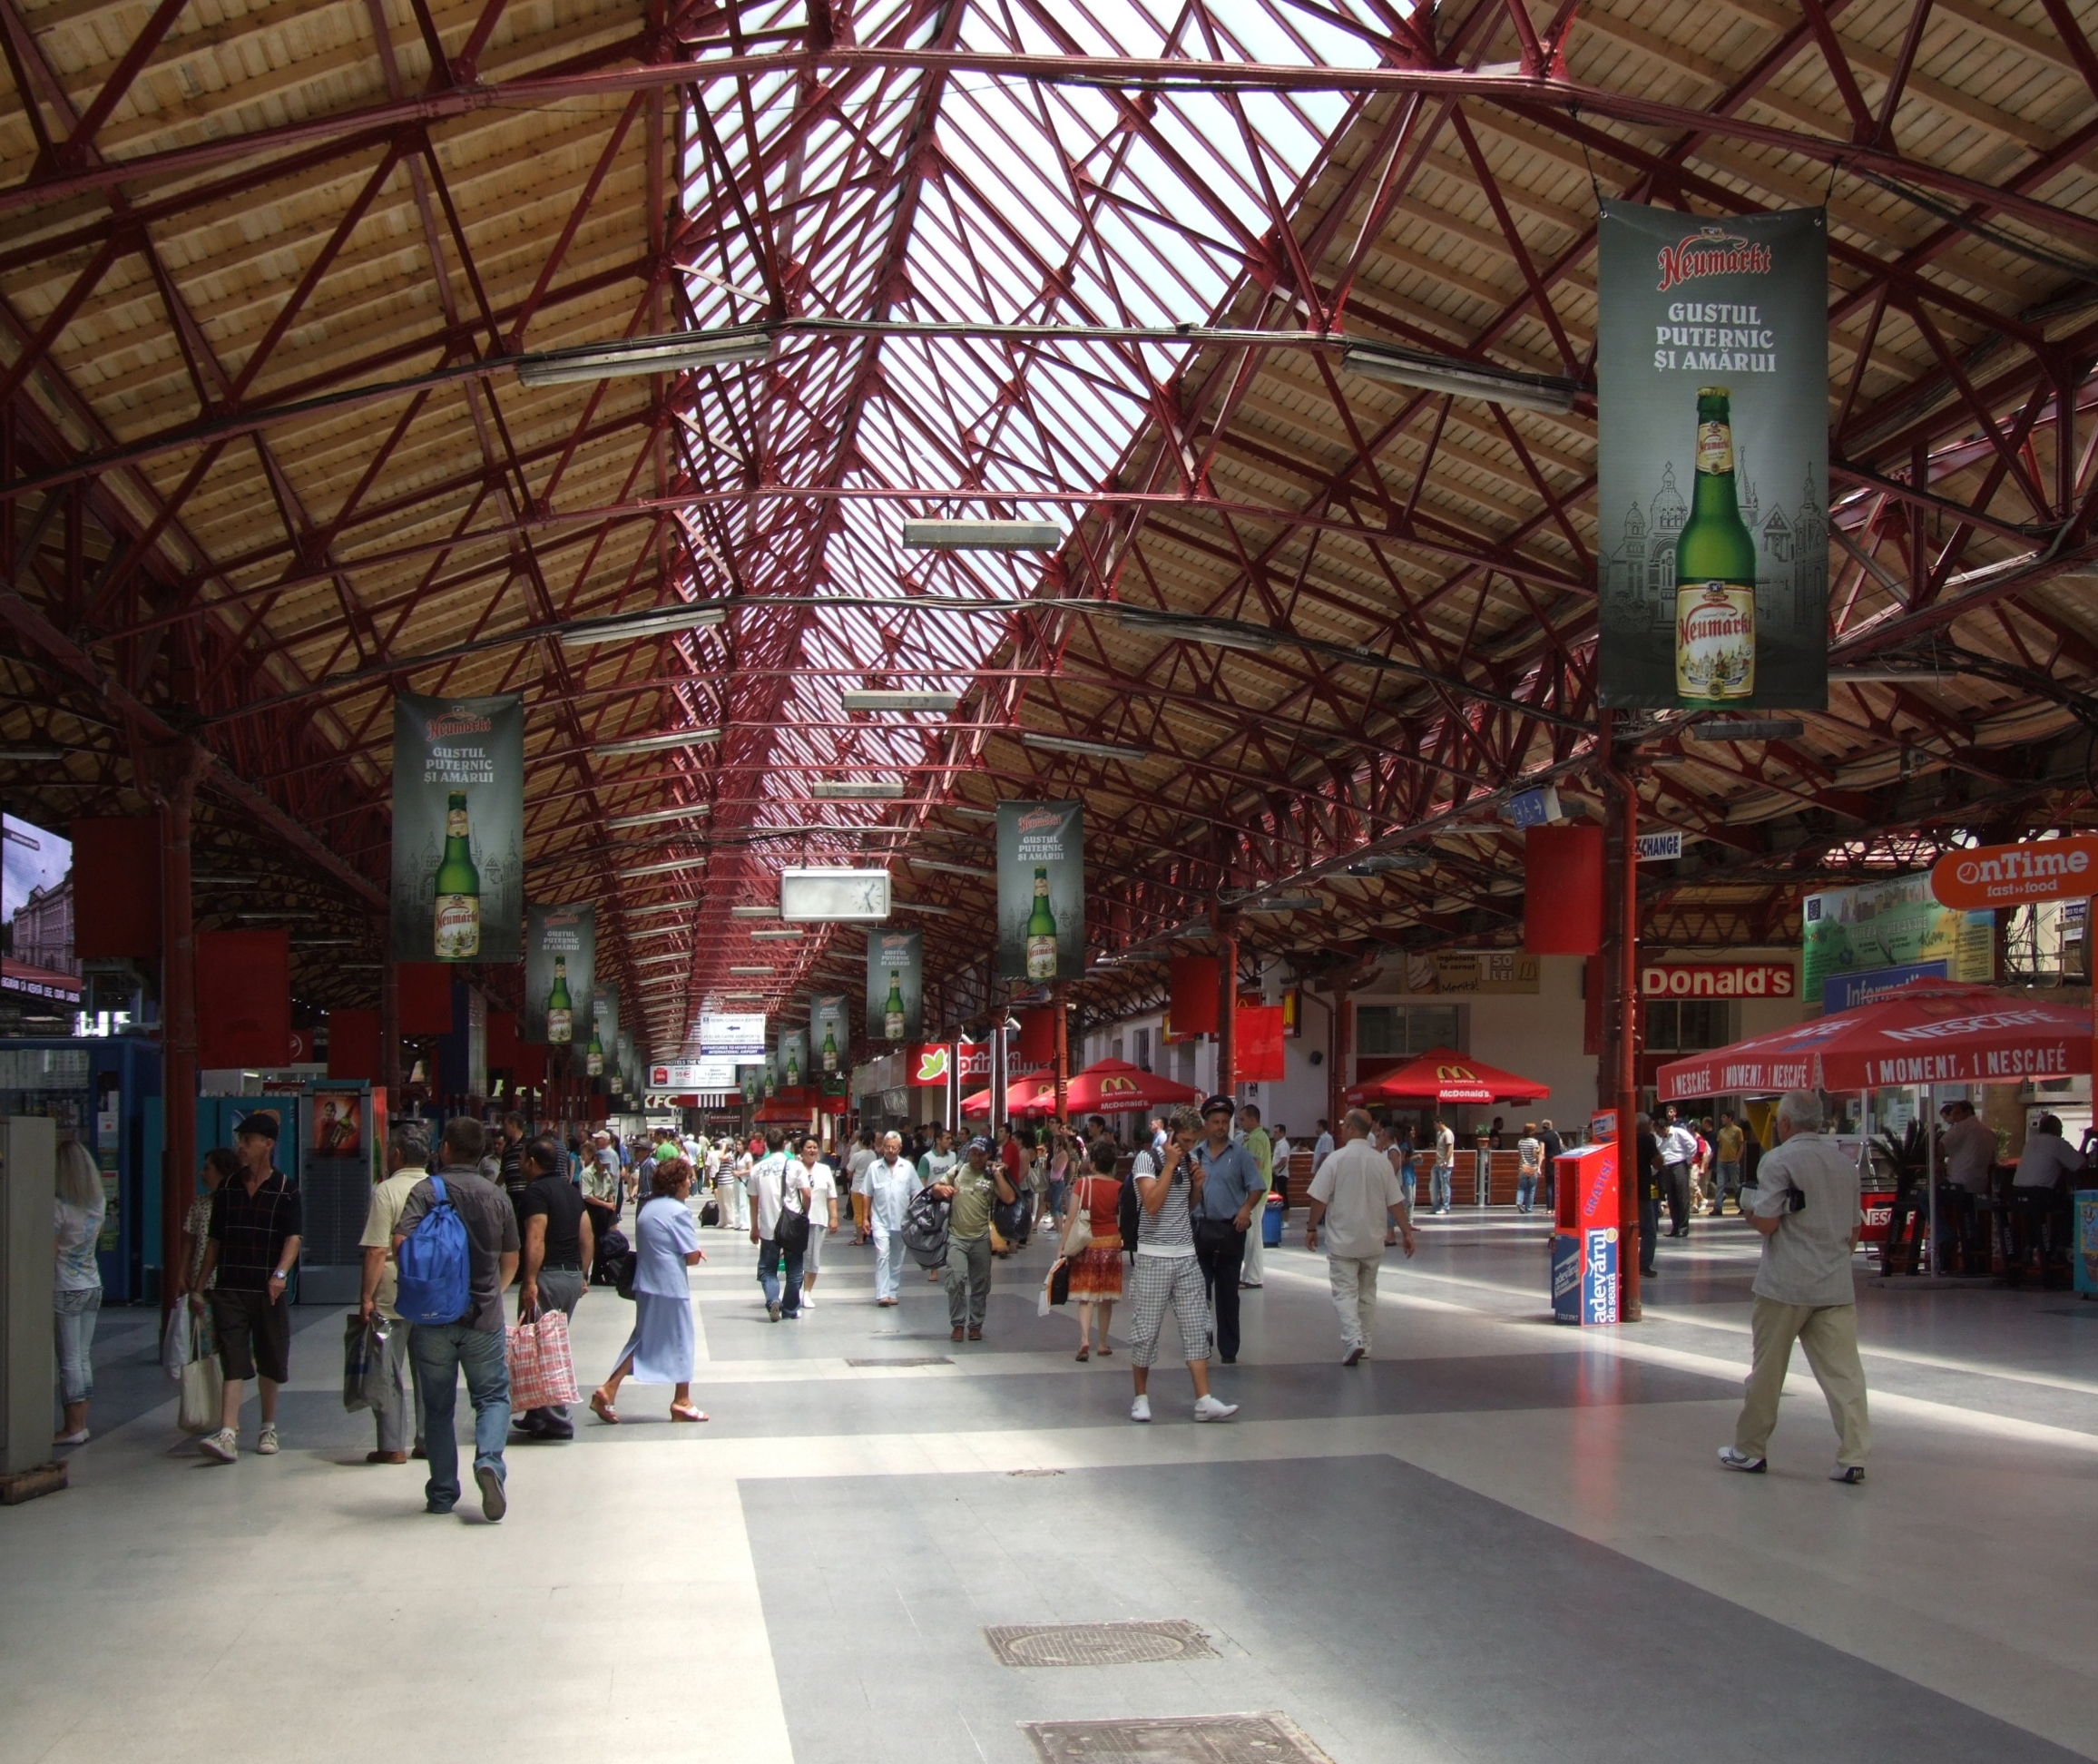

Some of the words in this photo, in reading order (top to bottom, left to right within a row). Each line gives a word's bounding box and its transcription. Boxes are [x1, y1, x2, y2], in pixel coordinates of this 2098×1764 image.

[1657, 234, 1771, 291] Neumarkt
[1668, 302, 1761, 325] GUSTUL
[1656, 326, 1774, 349] PUTERNIC
[1681, 348, 1776, 372] AMĂRUI
[1678, 603, 1752, 650] Neumarkt
[426, 712, 491, 741] Neumarkt
[433, 747, 485, 759] GUSTUL
[426, 759, 493, 771] PUTERNIC
[440, 769, 494, 783] AMĂRUI
[1018, 844, 1064, 852] PUTERNIC
[1023, 836, 1059, 844] GUSTUL
[1636, 835, 1679, 858] XCHANGE
[1956, 850, 2088, 884] OnTime
[1477, 955, 1491, 980] 1
[1493, 955, 1513, 966] 50
[1492, 970, 1513, 981] LEI
[1879, 1009, 2067, 1042] NESCAFÉ
[1866, 1061, 1873, 1084] 1
[1879, 1054, 1965, 1084] MOMENT,
[1973, 1053, 1979, 1075] 1
[1986, 1042, 2067, 1075] NESCAFÉ
[1676, 1063, 1711, 1096] NESCAFÉ
[1772, 1058, 1808, 1088] NESCAFÉ
[644, 1094, 679, 1108] KFC
[1101, 1099, 1152, 1110] McDonald's
[1438, 1089, 1491, 1098] McDonald's
[673, 1108, 681, 1116] M
[1584, 1159, 1614, 1216] GRATIS!
[1859, 1207, 1917, 1226] NESF
[1587, 1229, 1607, 1324] adevărul
[1606, 1272, 1616, 1306] seară
[1606, 1307, 1616, 1323] de
